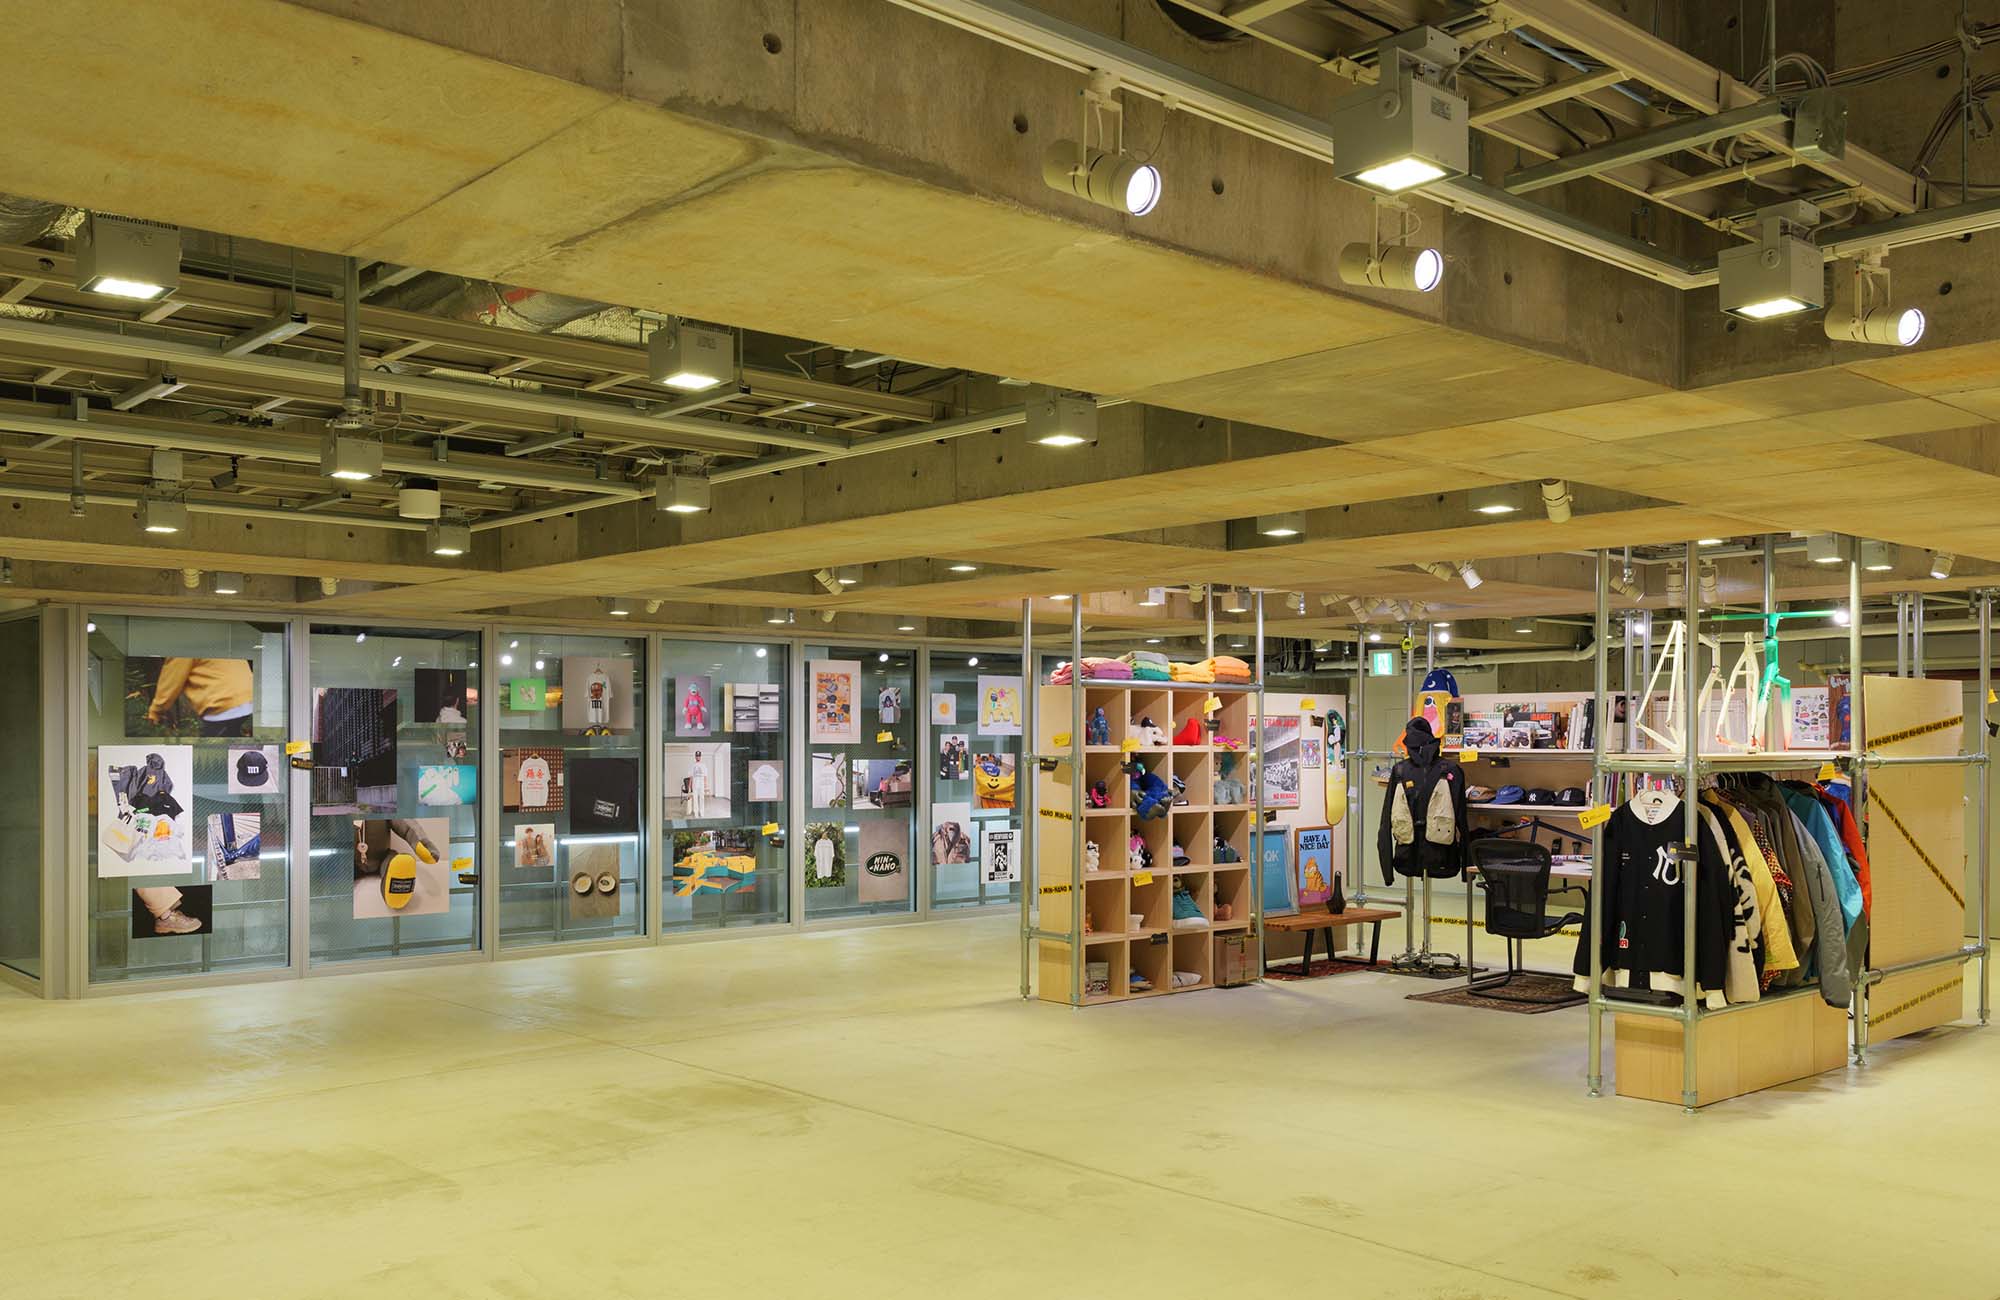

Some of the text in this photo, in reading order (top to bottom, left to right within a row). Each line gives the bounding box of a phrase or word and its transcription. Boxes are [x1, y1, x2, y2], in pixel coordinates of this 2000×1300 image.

[1303, 834, 1327, 843] HAVE A
[1299, 841, 1330, 851] NICE DAY
[1251, 849, 1279, 864] LOK
